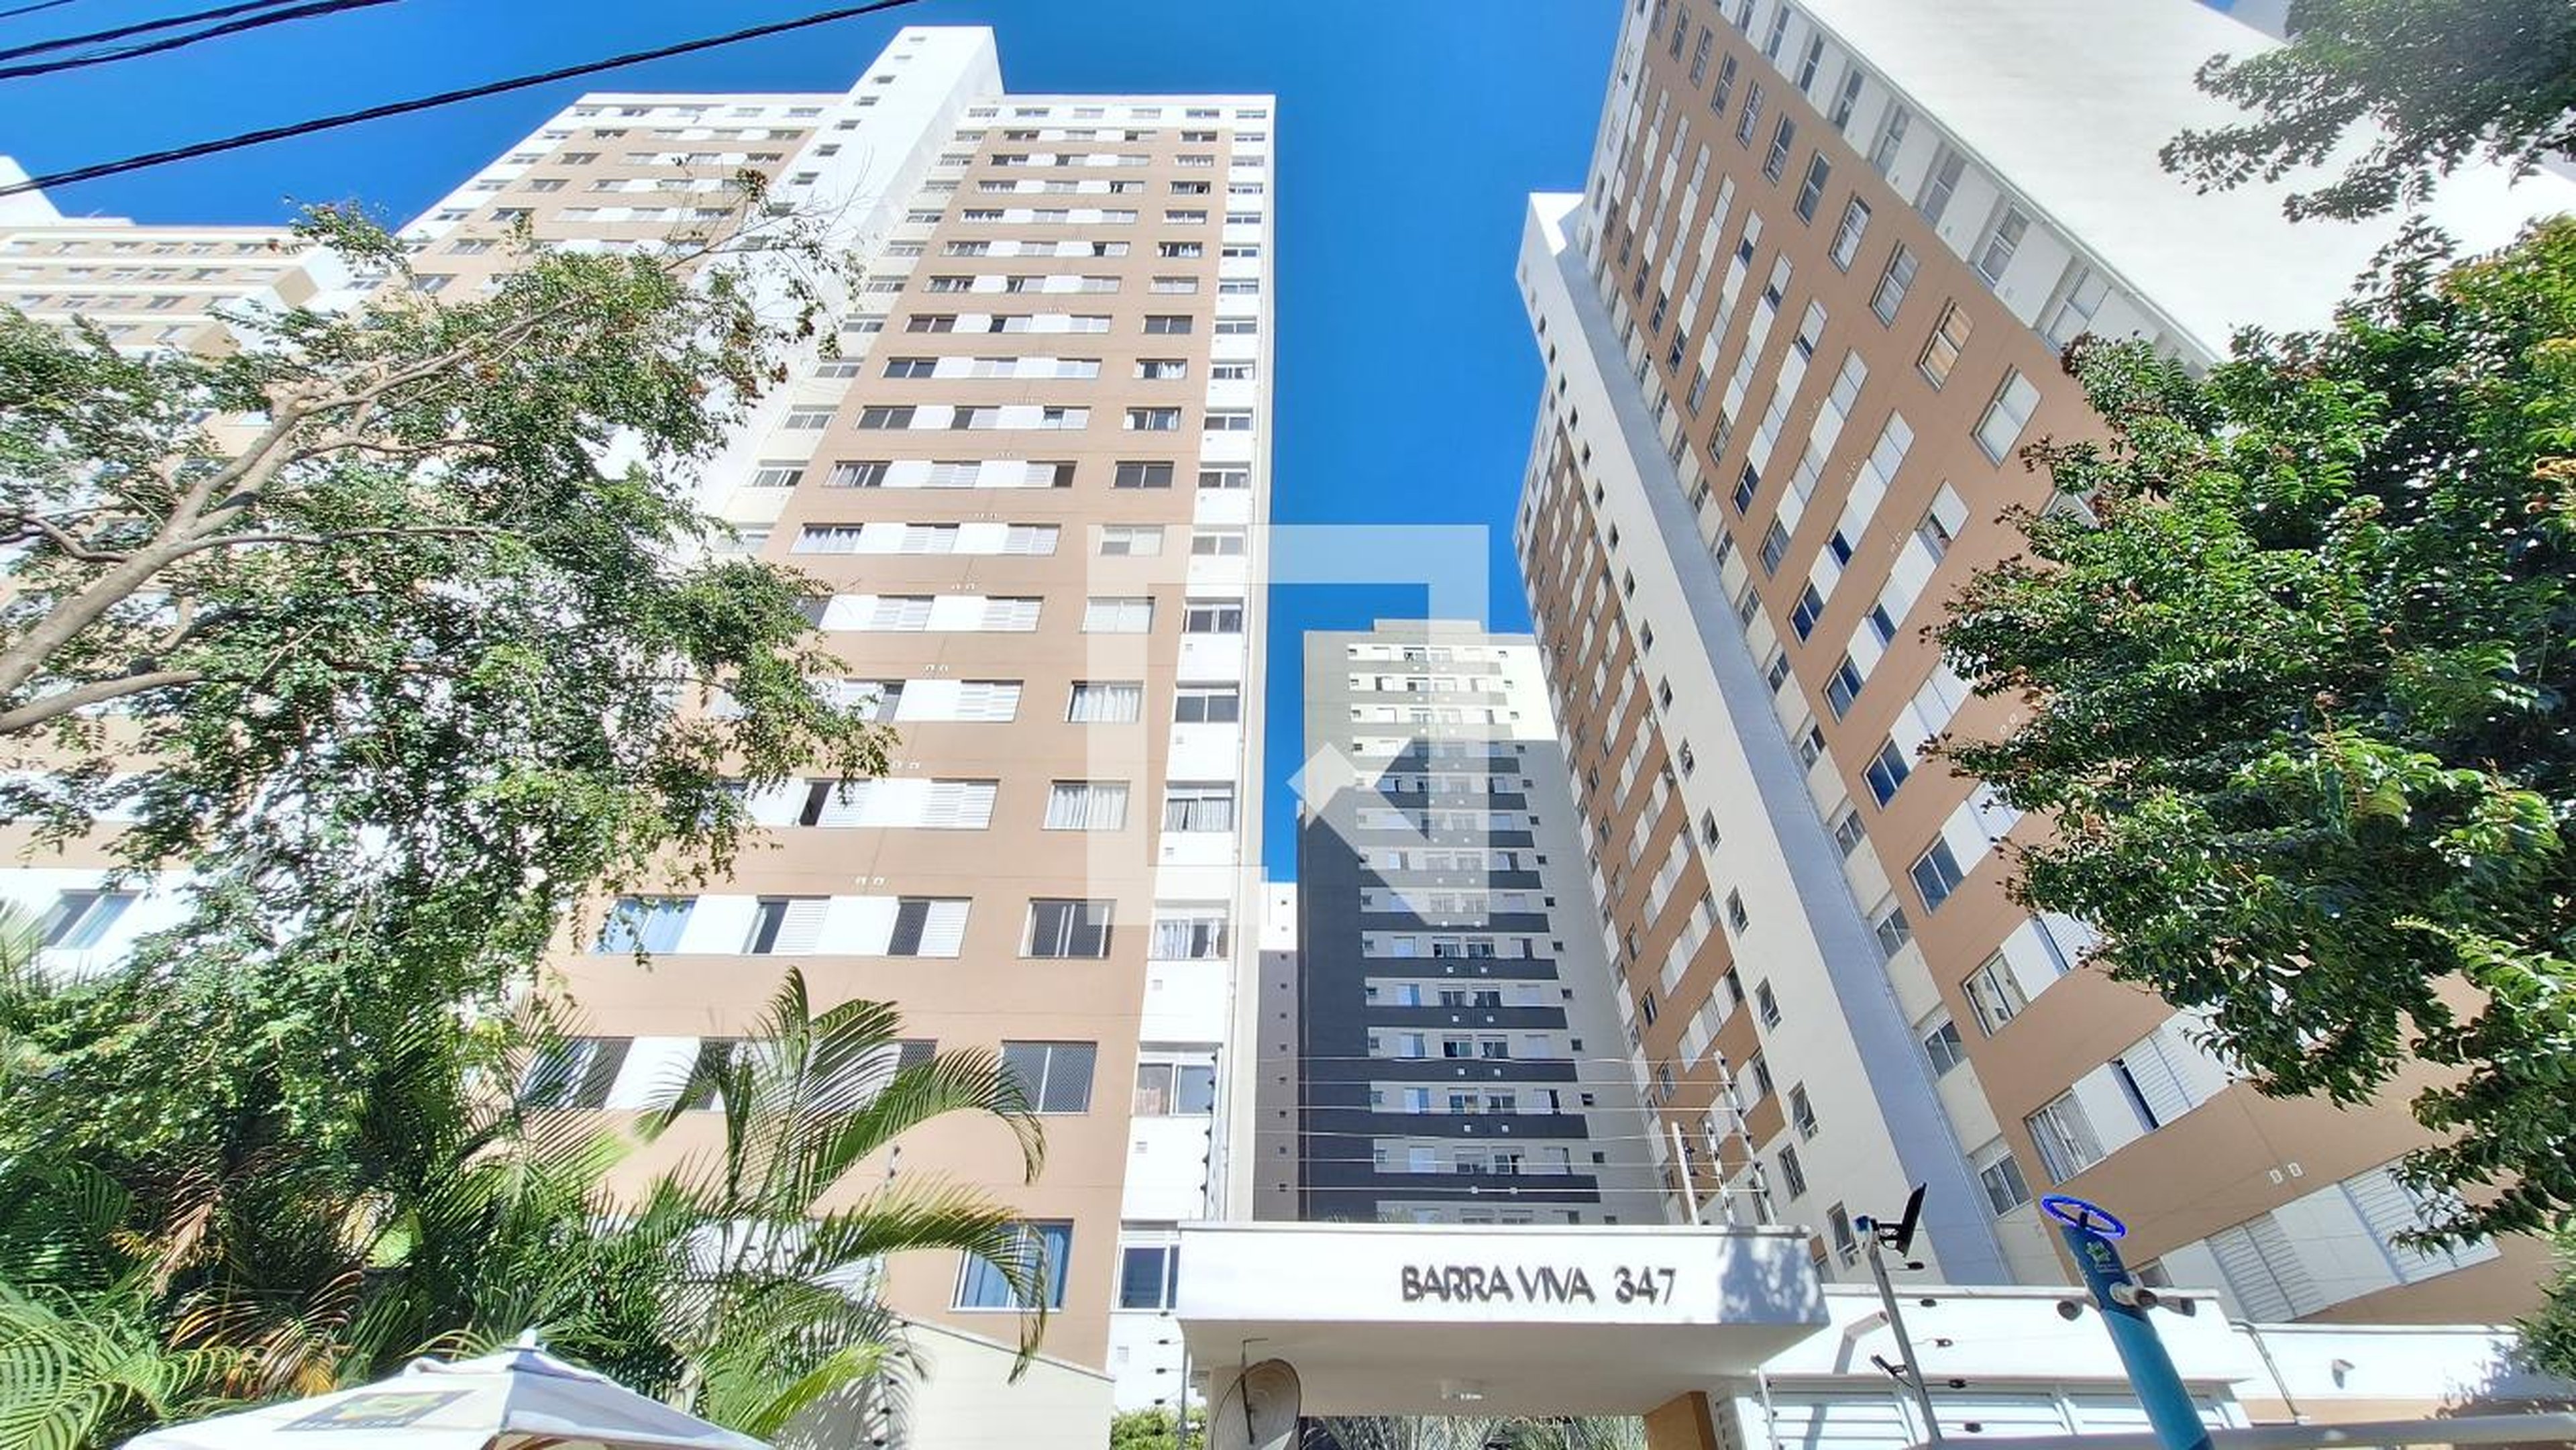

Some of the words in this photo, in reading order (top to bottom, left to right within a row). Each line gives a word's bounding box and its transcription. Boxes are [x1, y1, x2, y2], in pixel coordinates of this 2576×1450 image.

[1401, 1265, 1514, 1303] BARRA
[1516, 1265, 1597, 1304] VIVA
[1614, 1265, 1676, 1305] 347
